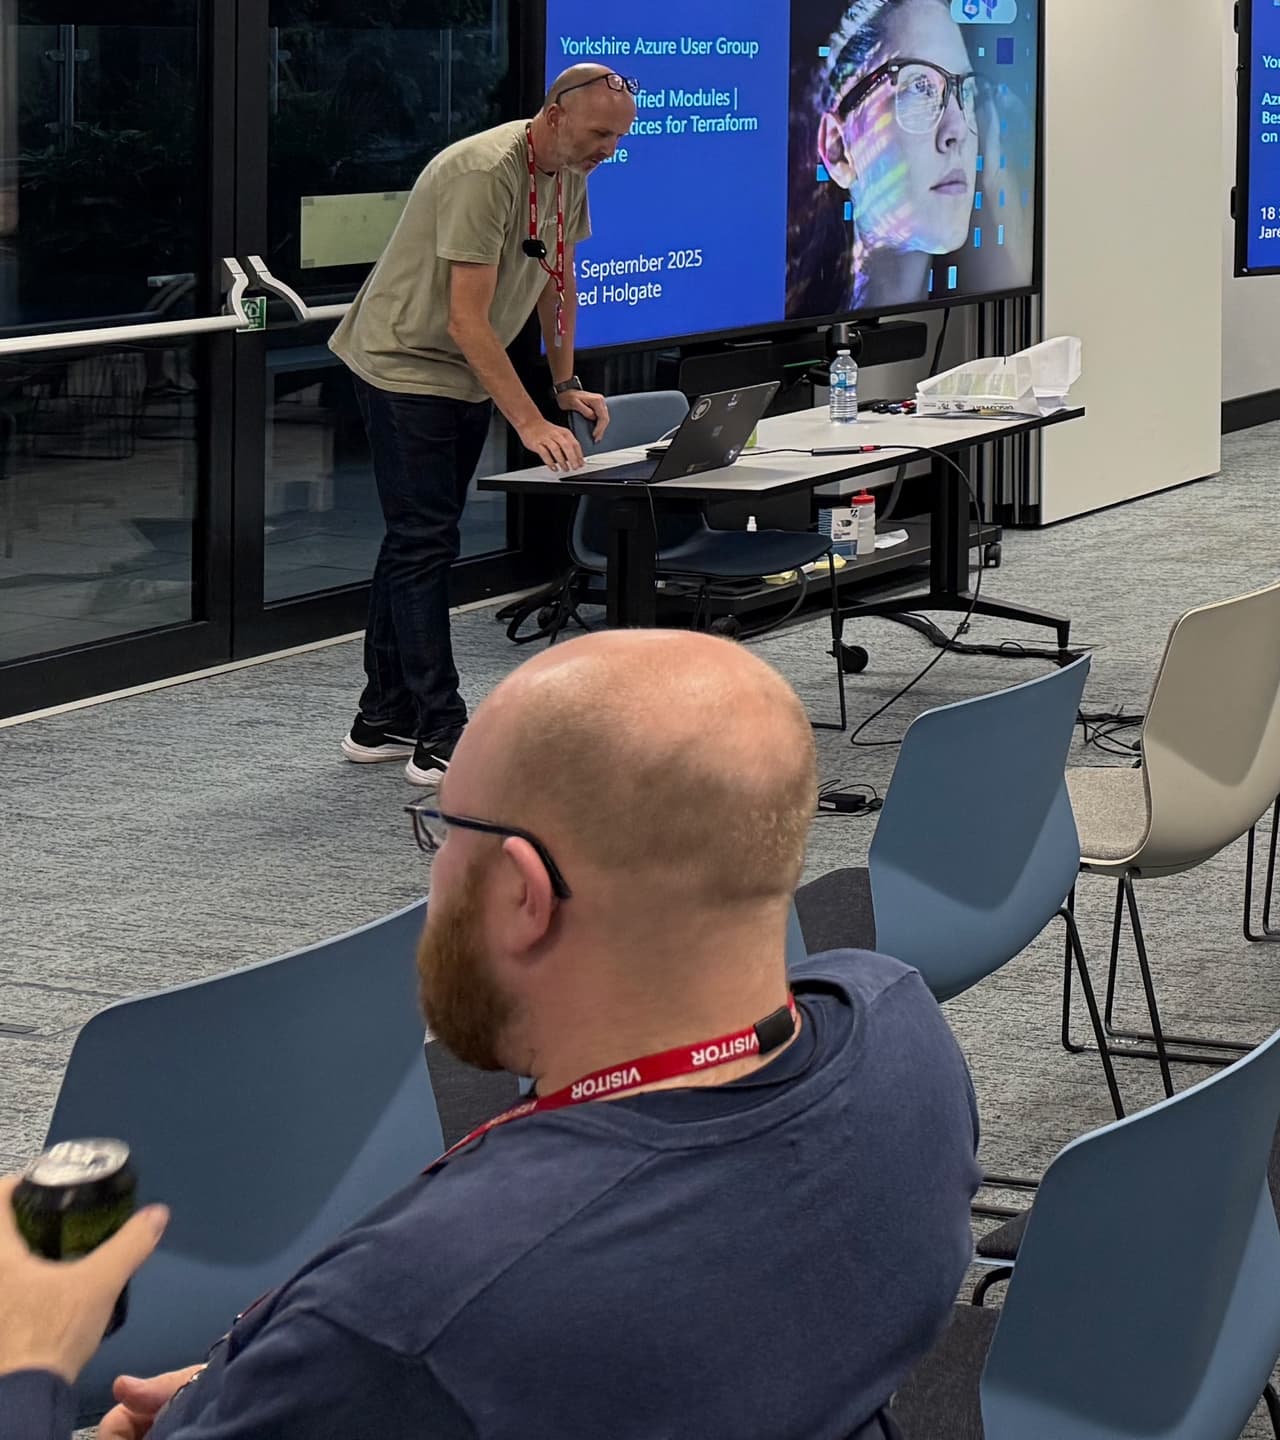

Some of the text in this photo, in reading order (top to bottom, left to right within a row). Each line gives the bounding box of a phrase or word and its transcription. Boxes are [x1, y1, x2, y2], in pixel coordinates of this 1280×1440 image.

[560, 36, 759, 59] Yorkshire Azure User Group
[669, 88, 730, 108] Modules
[666, 115, 687, 133] for
[690, 114, 758, 133] Terraform
[1261, 131, 1278, 143] on
[1260, 206, 1276, 220] 18
[581, 254, 664, 281] September
[667, 249, 703, 269] 2025
[602, 282, 662, 306] Holgate
[691, 1032, 760, 1066] VISITOR
[571, 1067, 642, 1100] VISITOR
